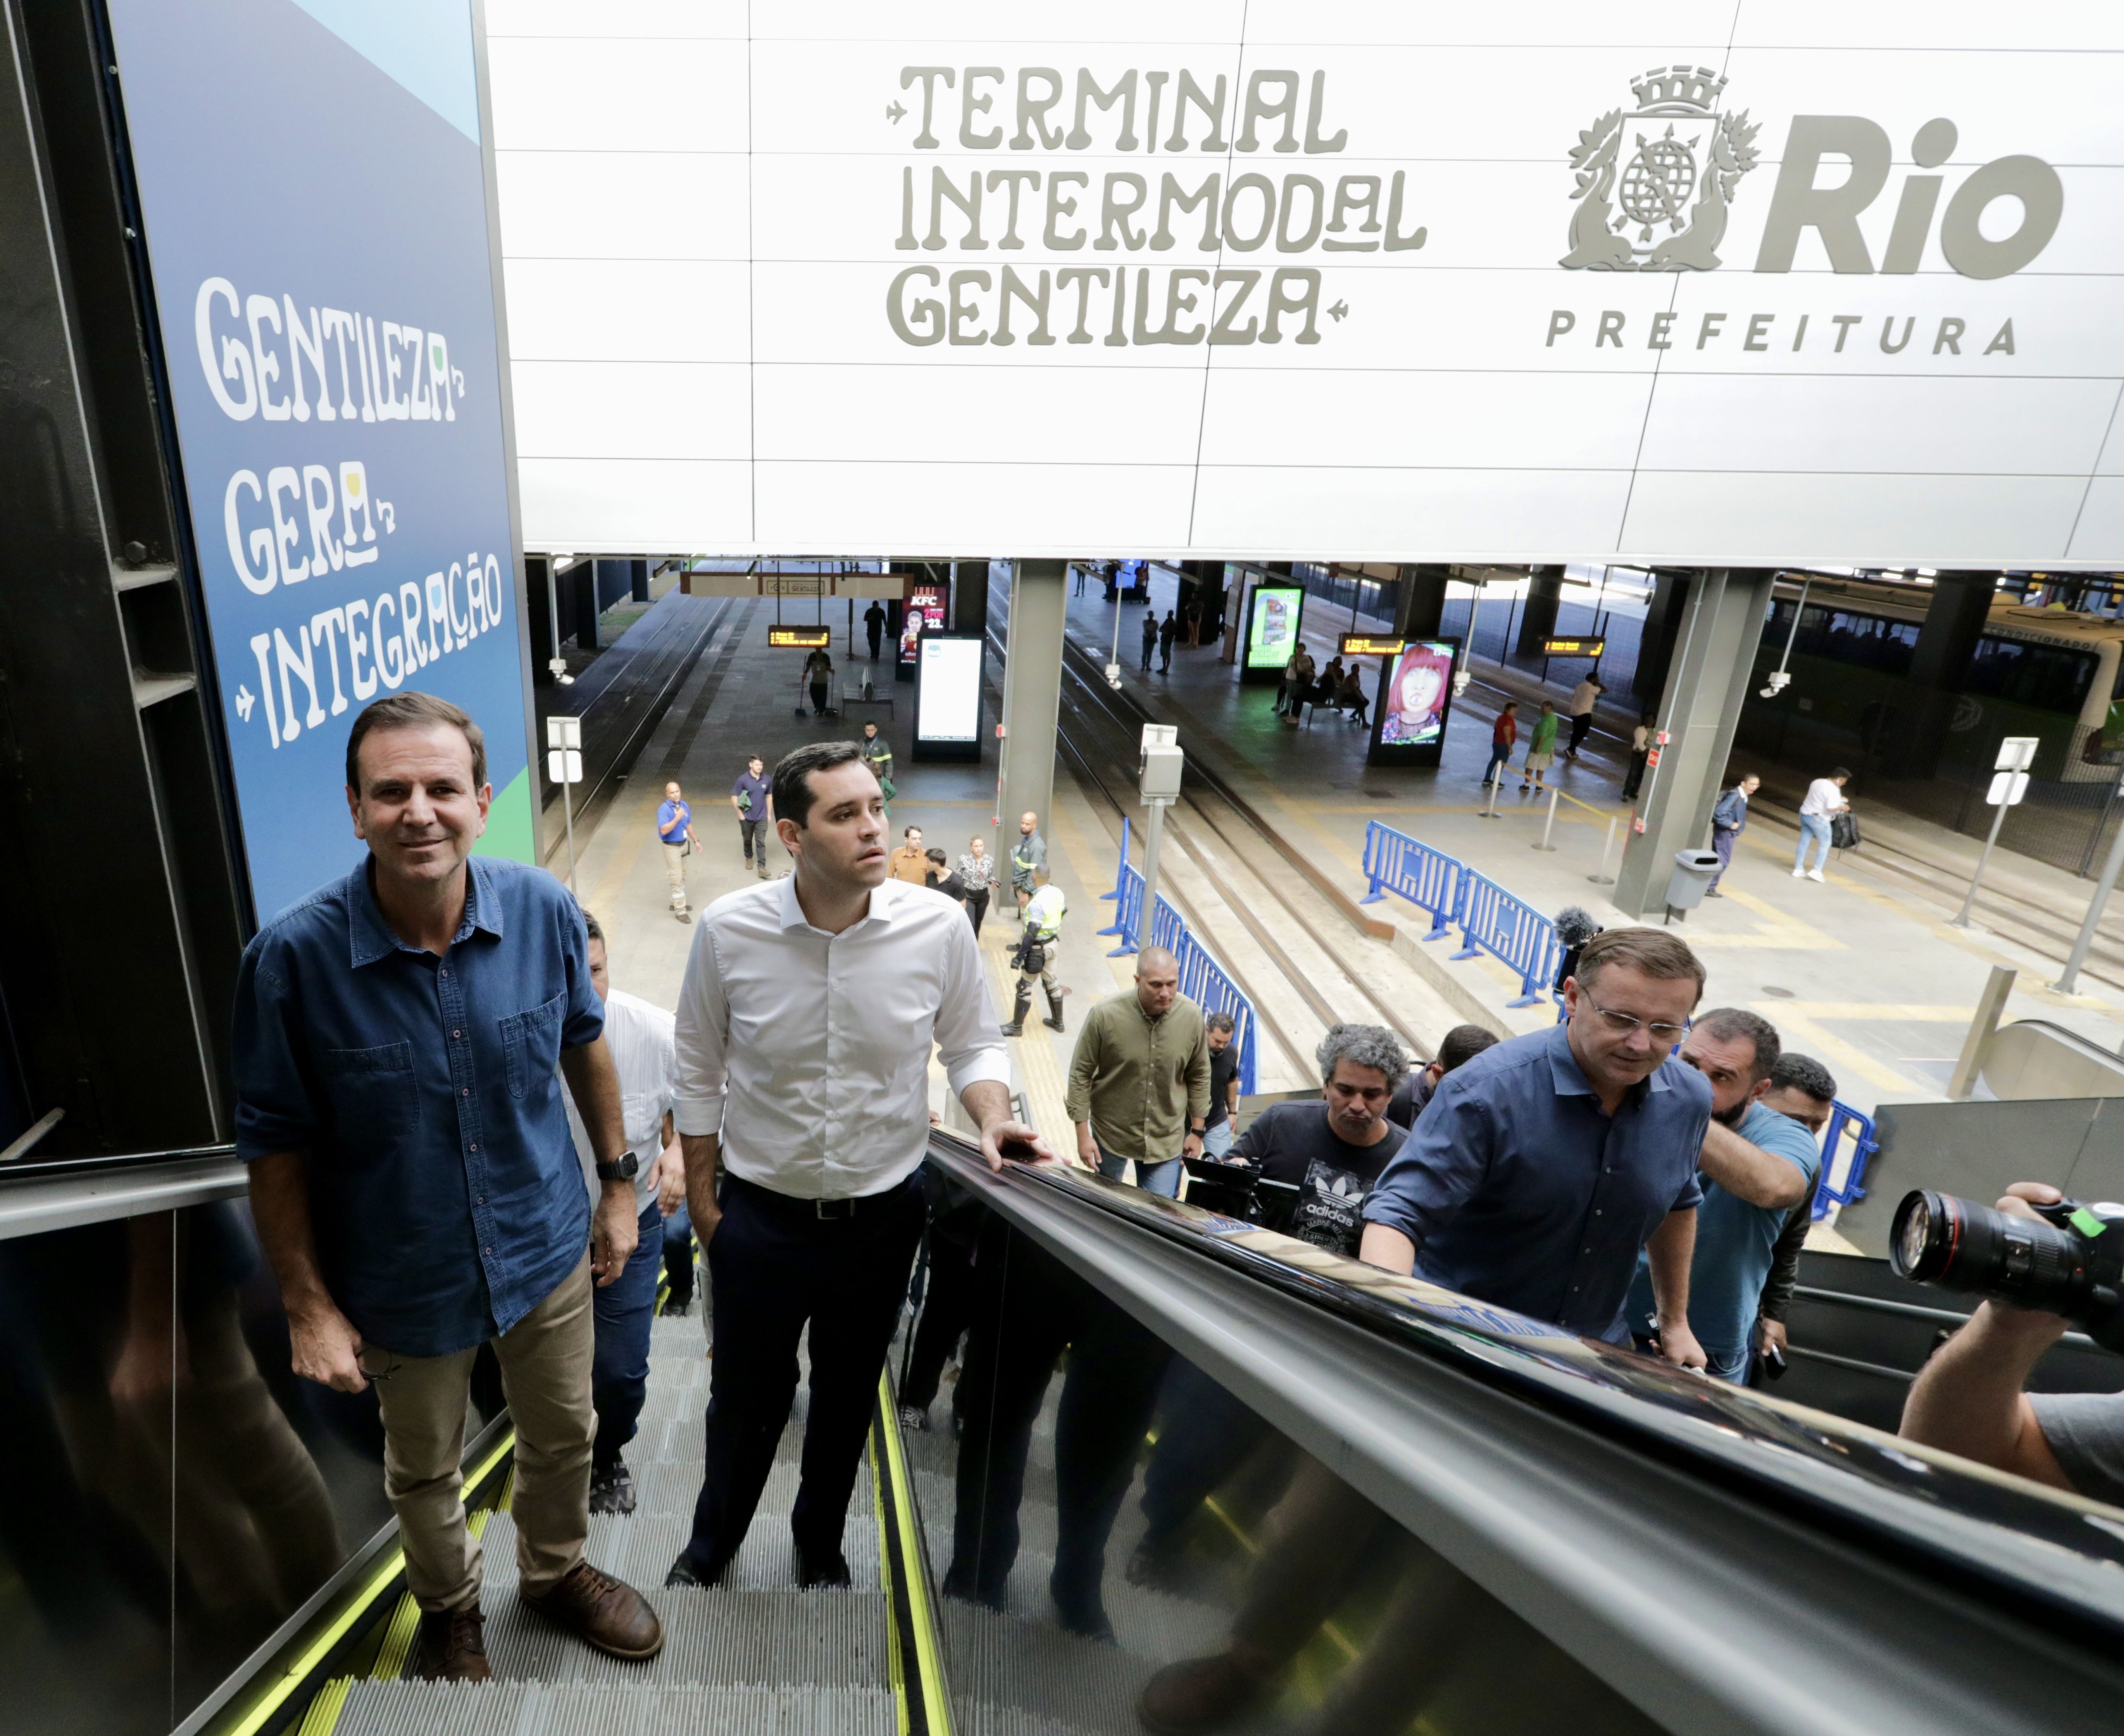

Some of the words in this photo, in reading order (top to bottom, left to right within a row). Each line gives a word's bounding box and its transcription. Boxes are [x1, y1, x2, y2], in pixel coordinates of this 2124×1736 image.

[900, 65, 1348, 154] TERMINAL
[895, 165, 1427, 253] INTERMODAL
[1753, 114, 2064, 280] Rio
[886, 264, 1322, 347] GENTILEZA
[1545, 310, 2016, 356] PREFEITURA
[195, 277, 456, 423] GENTILEZA
[224, 461, 378, 595] GERA
[910, 596, 938, 606] KFC
[250, 551, 502, 749] INTEGRAÇÃO
[1307, 1204, 1354, 1227] adidas
[1307, 1219, 1331, 1227] MARKE
[1332, 1224, 1343, 1234] MIT
